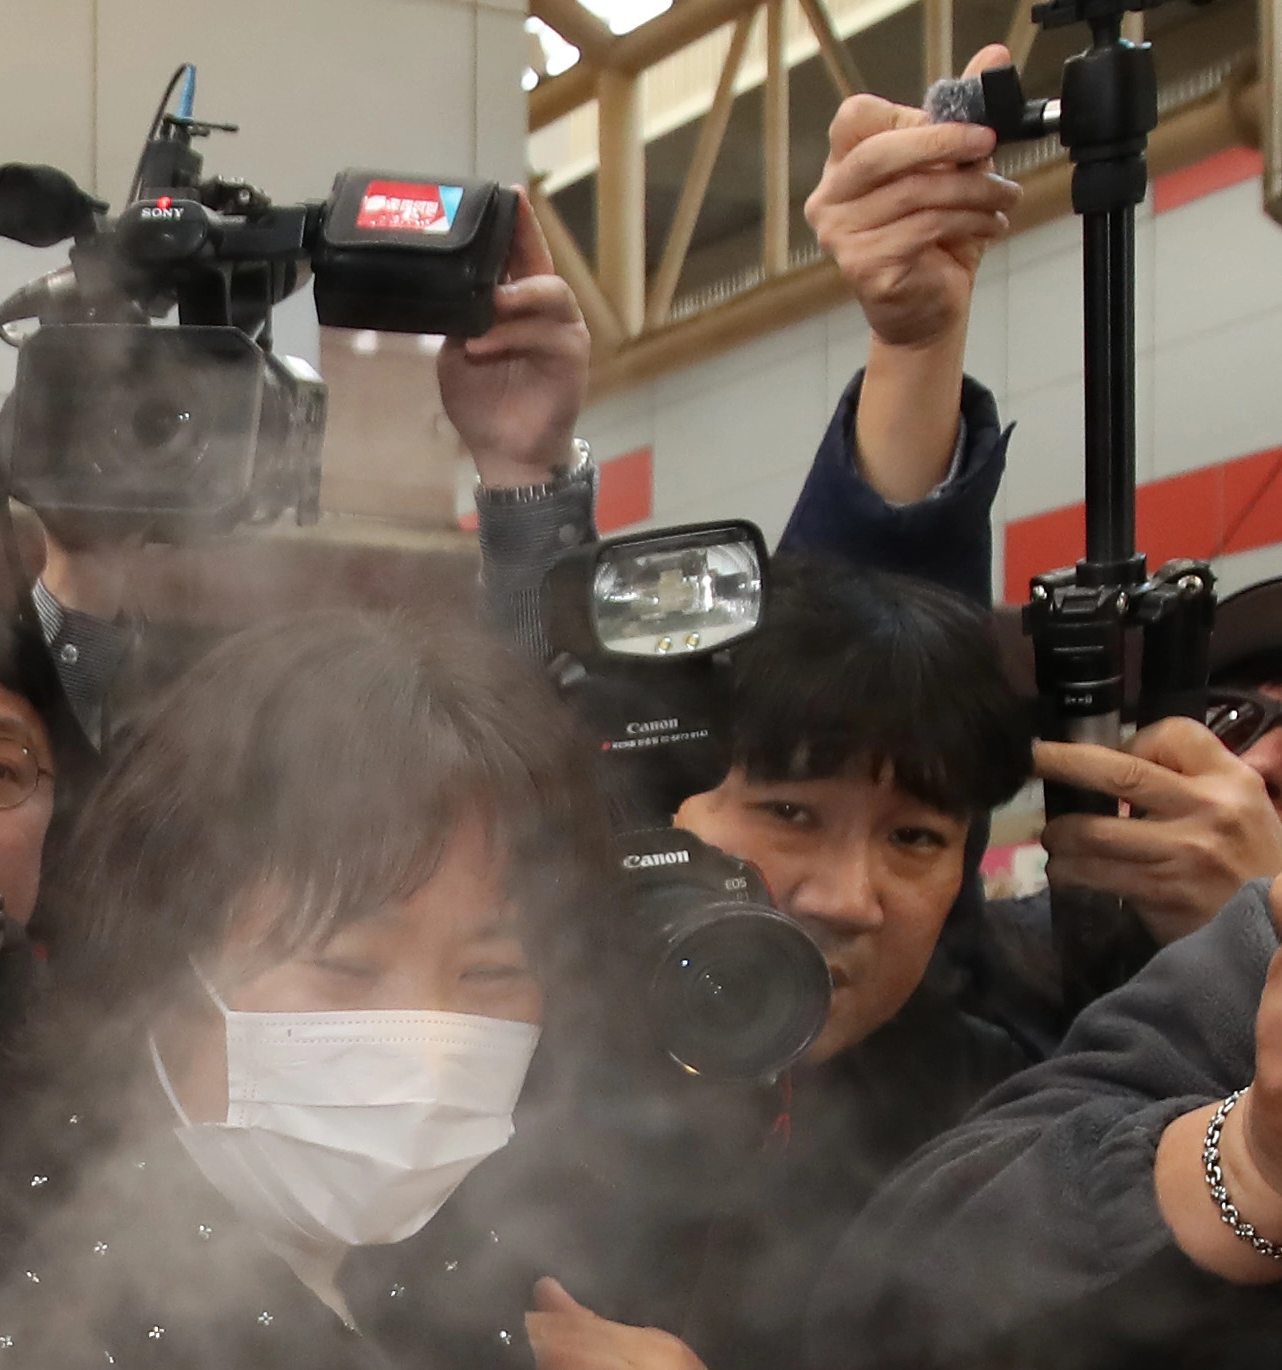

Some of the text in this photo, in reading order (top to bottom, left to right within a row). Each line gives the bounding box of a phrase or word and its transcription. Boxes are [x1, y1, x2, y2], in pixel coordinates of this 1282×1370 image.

[140, 207, 185, 219] SONY
[626, 718, 679, 735] Canon
[623, 849, 691, 869] Canon
[725, 876, 748, 891] EOS
